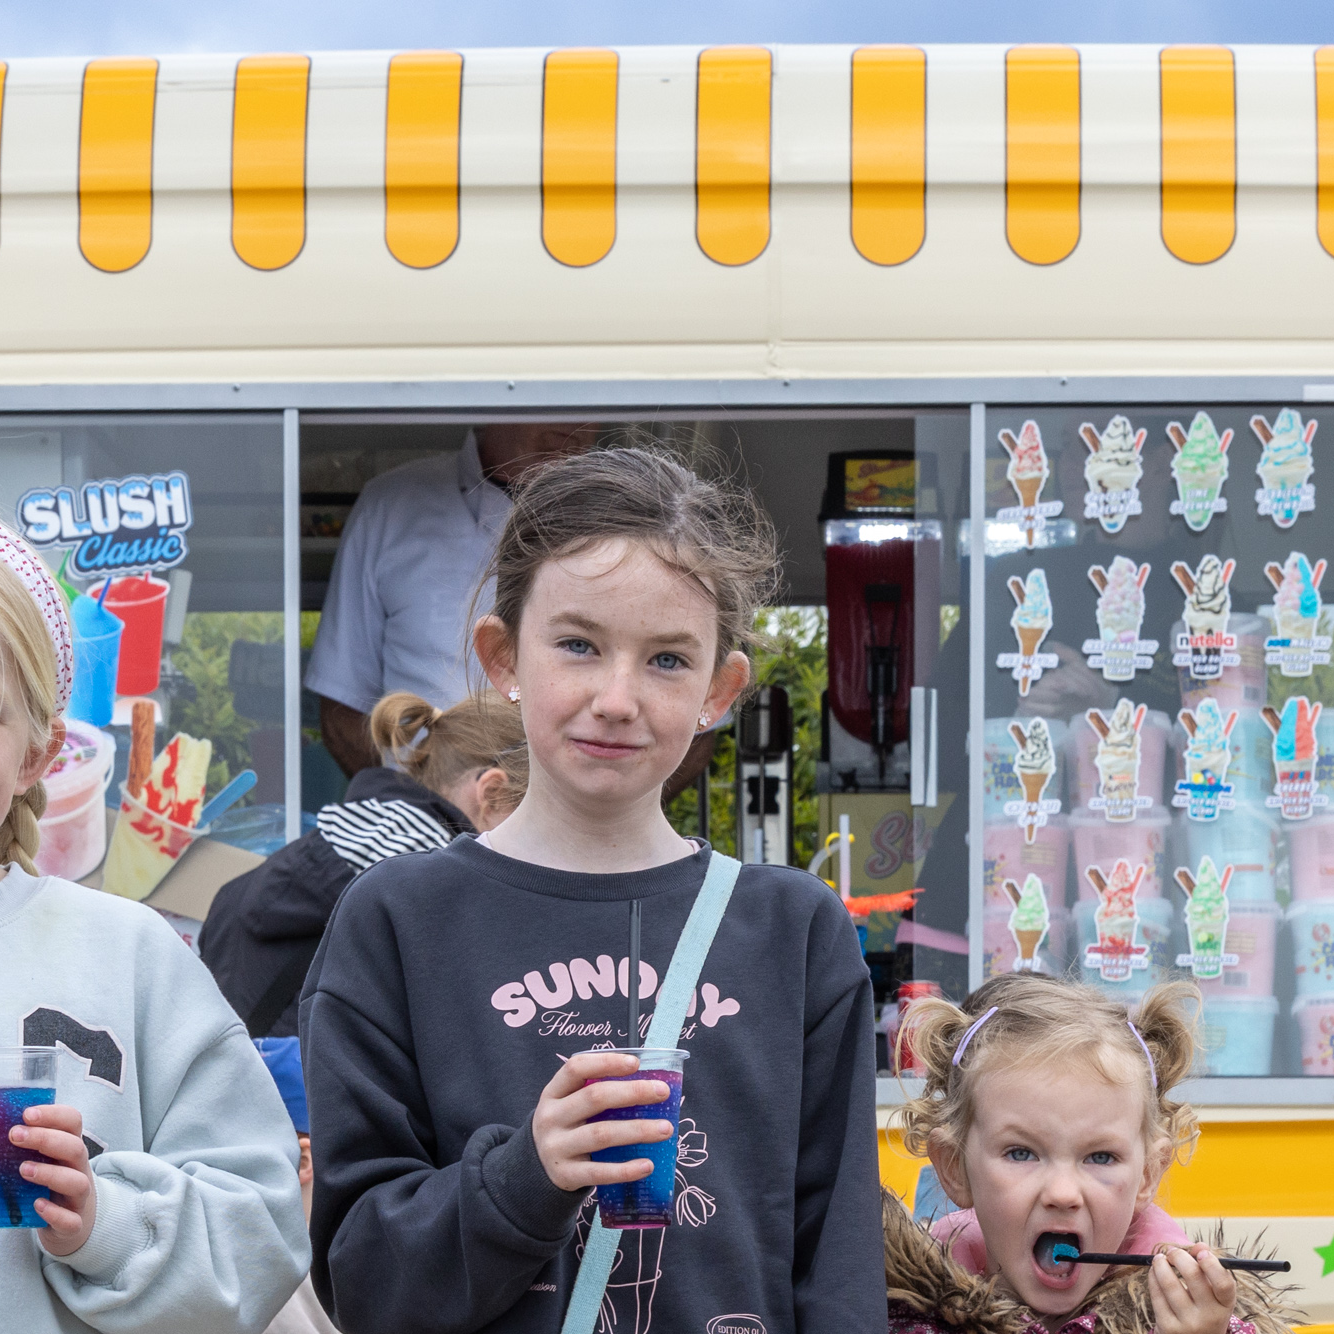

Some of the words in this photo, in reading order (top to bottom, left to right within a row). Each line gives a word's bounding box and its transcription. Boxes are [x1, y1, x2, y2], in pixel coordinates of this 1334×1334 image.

[23, 477, 187, 542] SLUSH
[77, 527, 182, 569] Classic
[1180, 631, 1235, 647] nutella
[539, 1011, 612, 1037] Flower
